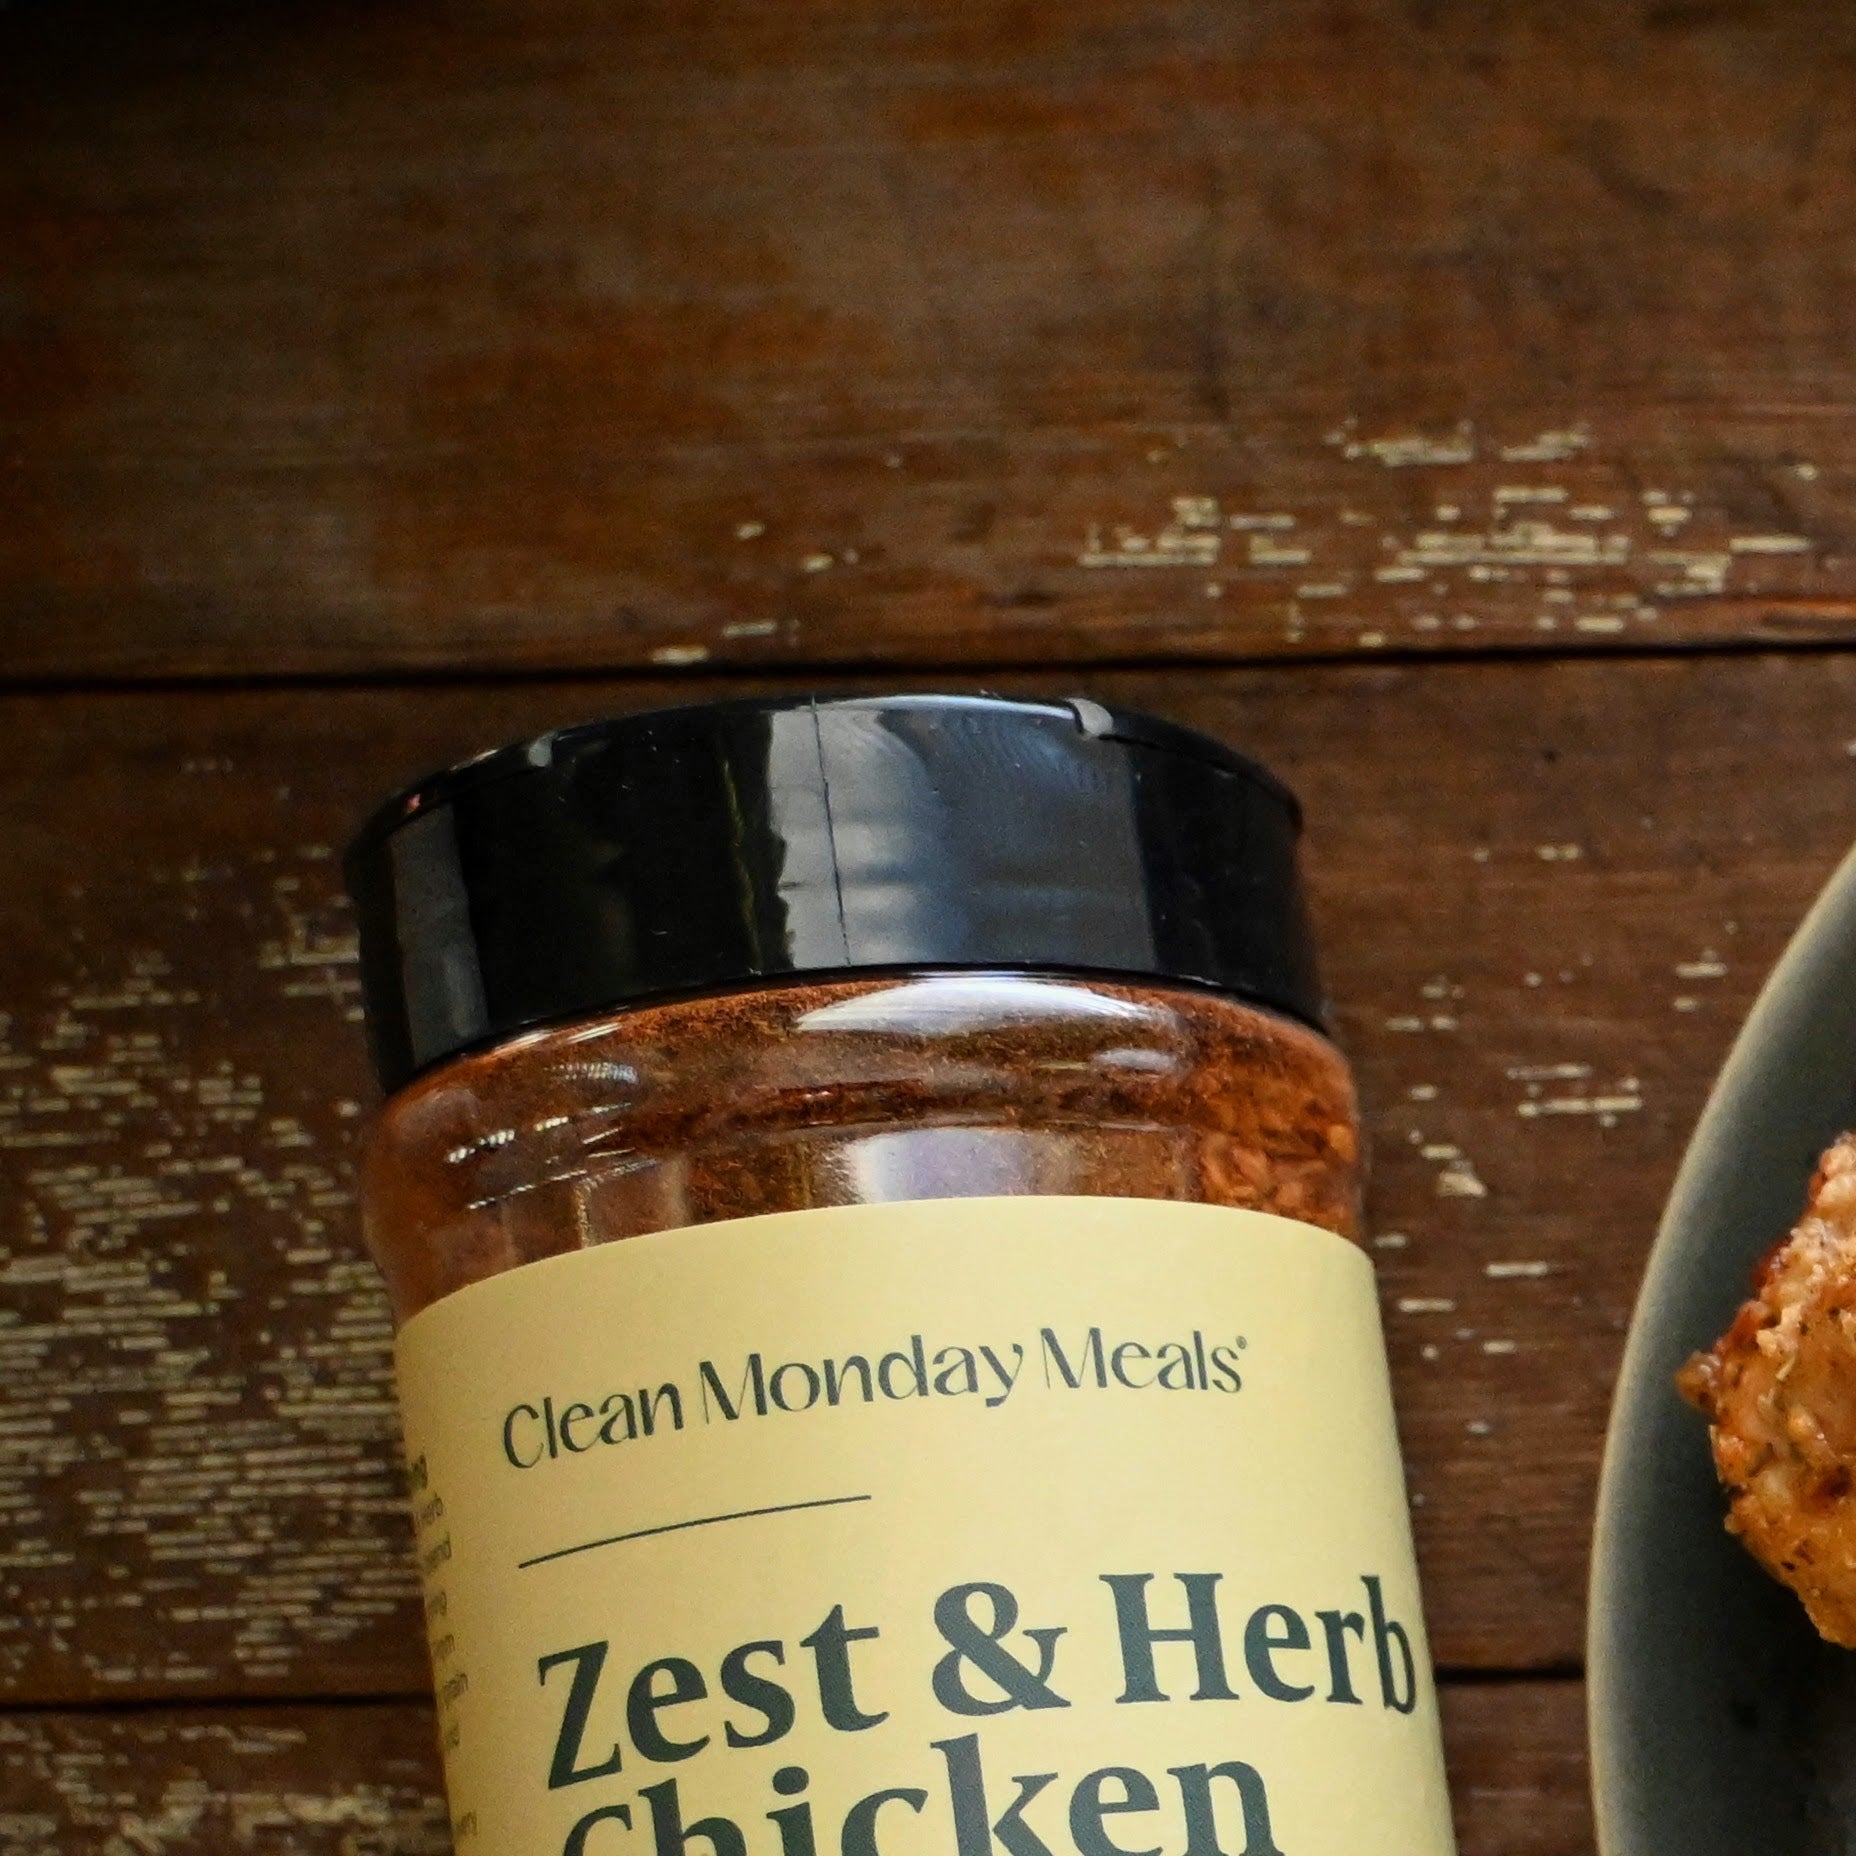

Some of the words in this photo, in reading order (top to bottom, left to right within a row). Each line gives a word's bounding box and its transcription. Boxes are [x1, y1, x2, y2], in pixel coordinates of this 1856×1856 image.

[500, 1382, 685, 1470] Clean
[698, 1334, 1025, 1408] Monday
[536, 1603, 891, 1792] Zest
[931, 1581, 1073, 1717] &
[1098, 1572, 1417, 1716] Herb
